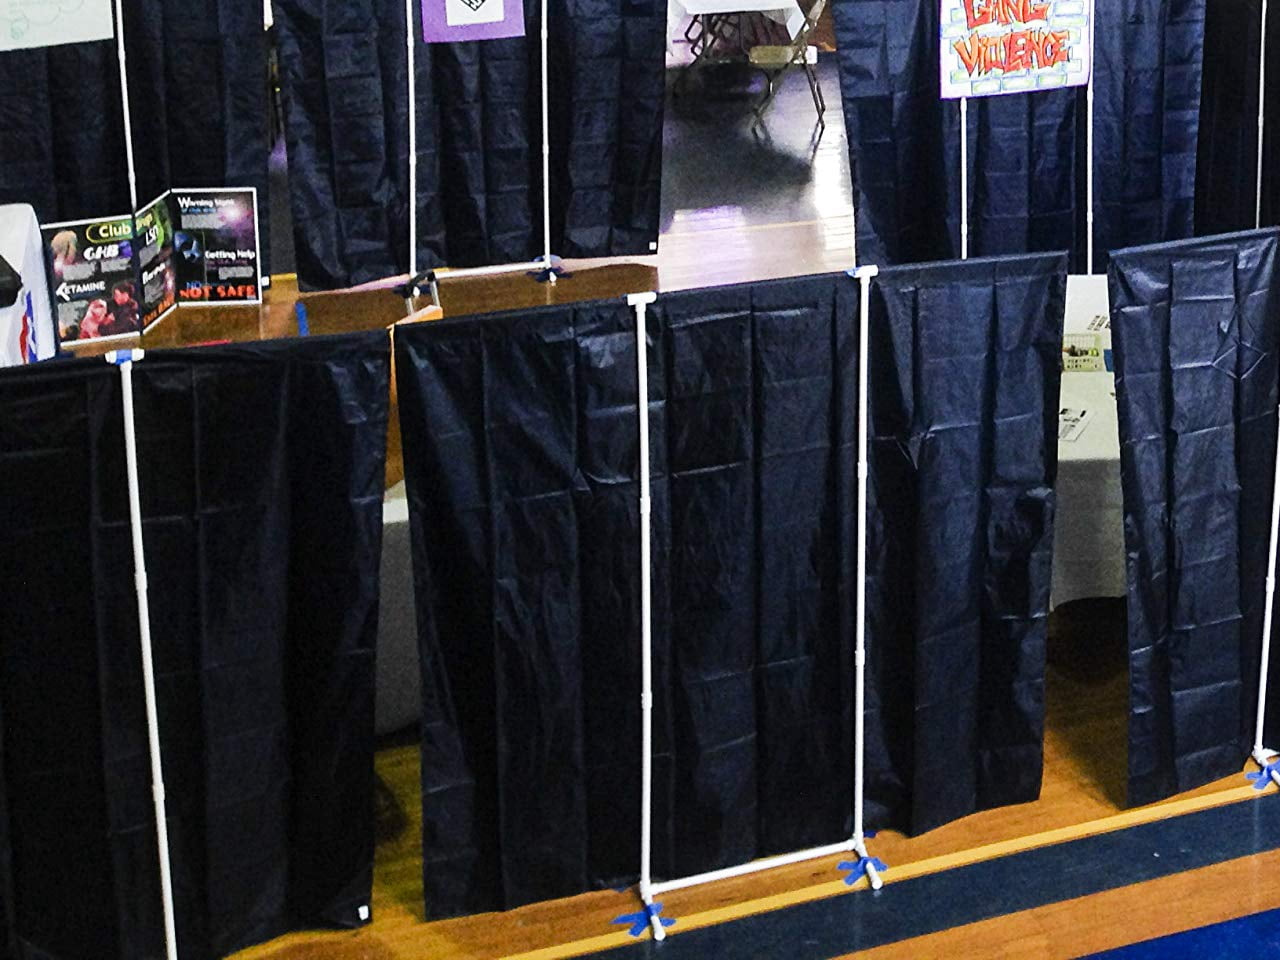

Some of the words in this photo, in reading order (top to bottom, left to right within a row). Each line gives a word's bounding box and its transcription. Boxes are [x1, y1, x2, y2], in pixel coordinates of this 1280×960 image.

[953, 27, 1070, 78] VIOLENCE
[99, 223, 131, 238] Club
[83, 244, 120, 261] GHB
[204, 250, 236, 261] Getting
[237, 249, 256, 259] Help
[56, 281, 106, 301] KETAMINE
[179, 285, 213, 299] NOT
[217, 285, 255, 298] SAFE
